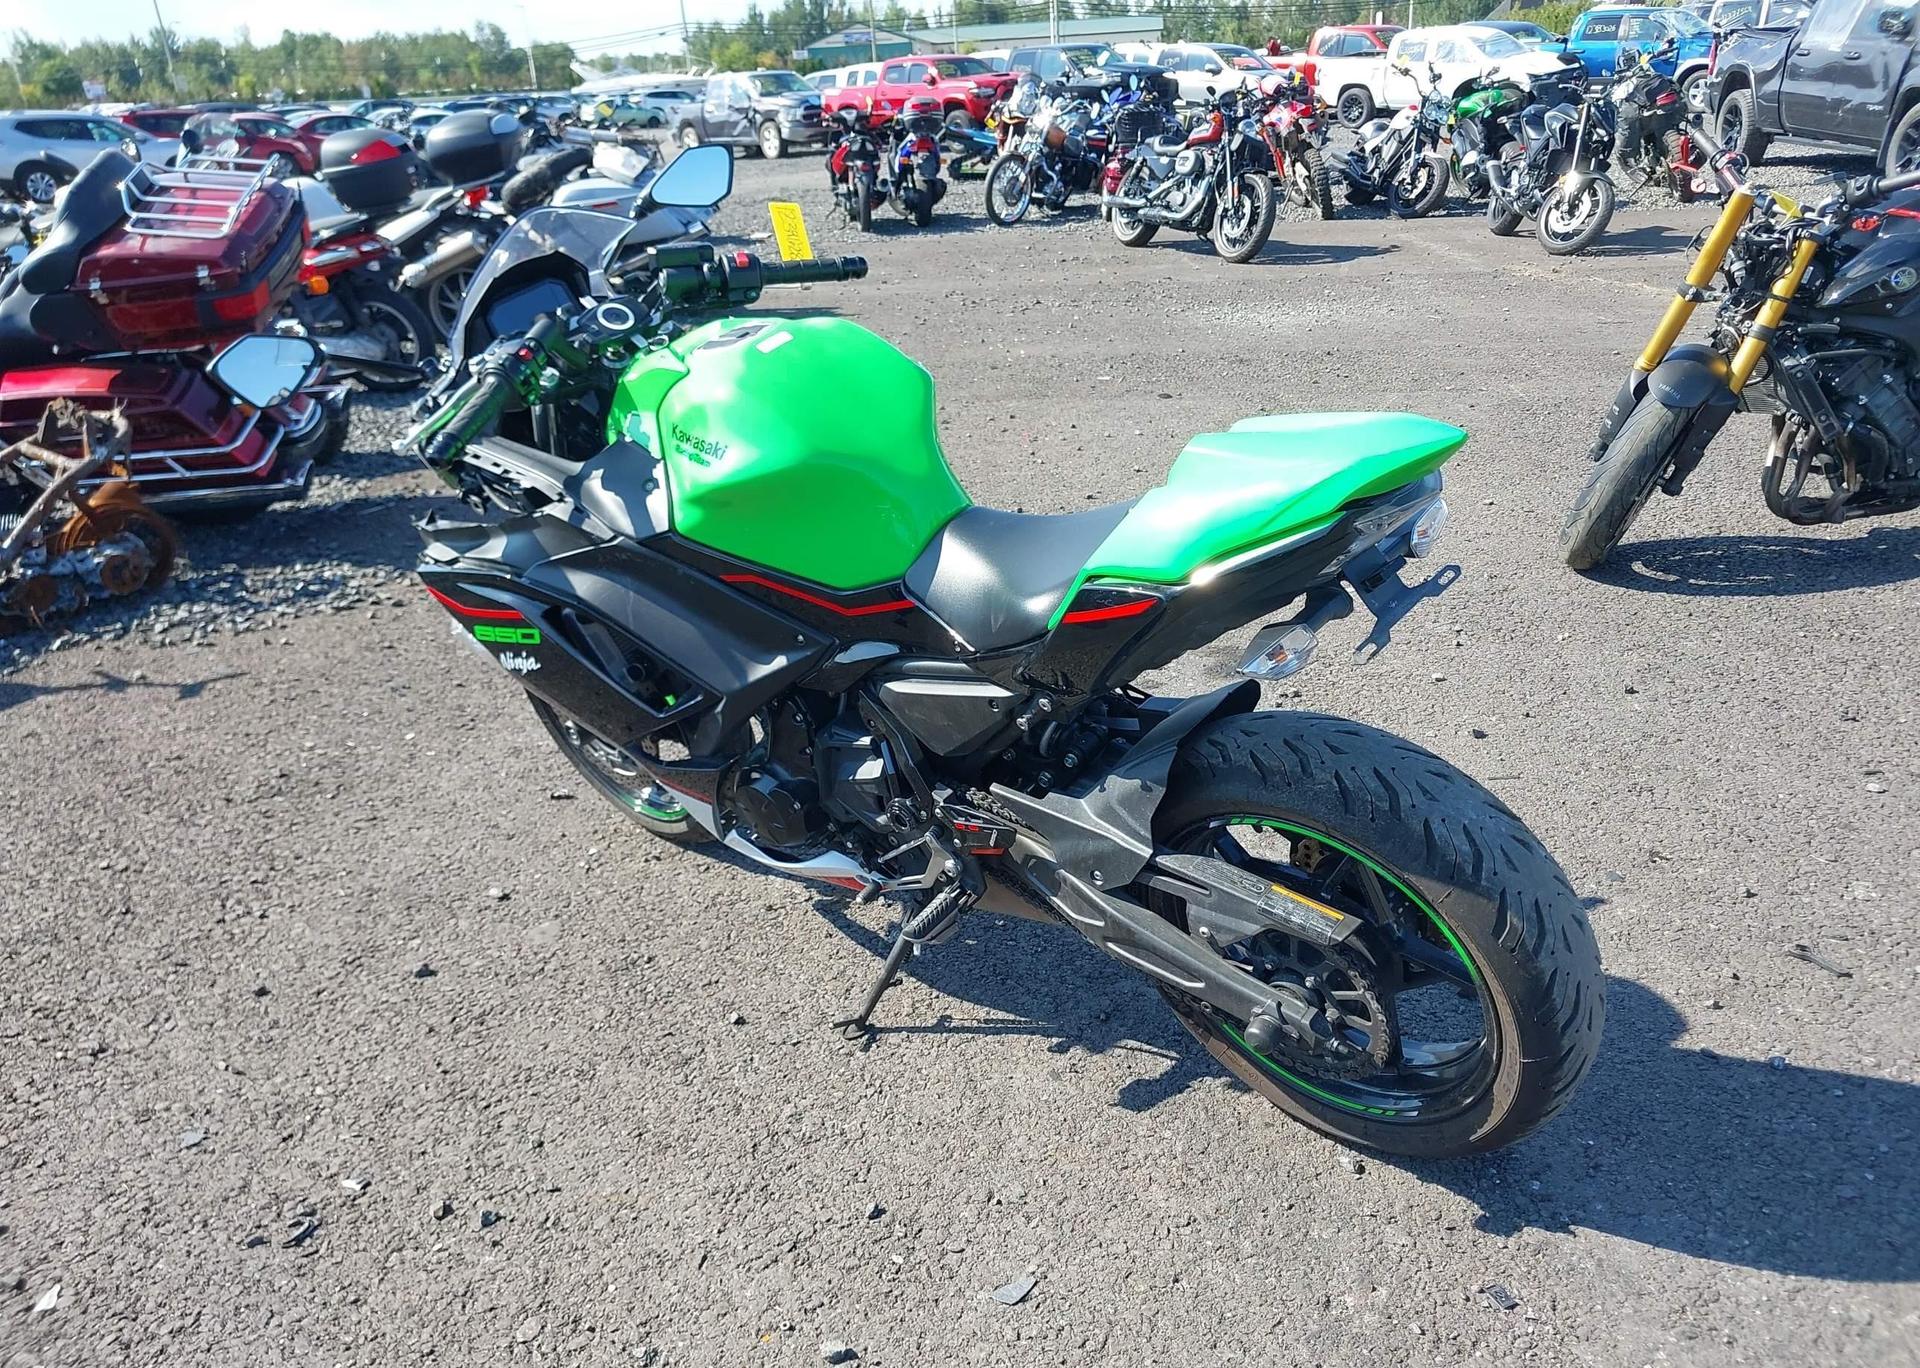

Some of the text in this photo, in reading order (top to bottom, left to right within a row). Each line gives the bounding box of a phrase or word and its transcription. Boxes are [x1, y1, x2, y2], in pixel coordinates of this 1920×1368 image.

[671, 422, 728, 461] Kawasaki
[473, 624, 541, 645] 650
[500, 651, 541, 676] Ninja
